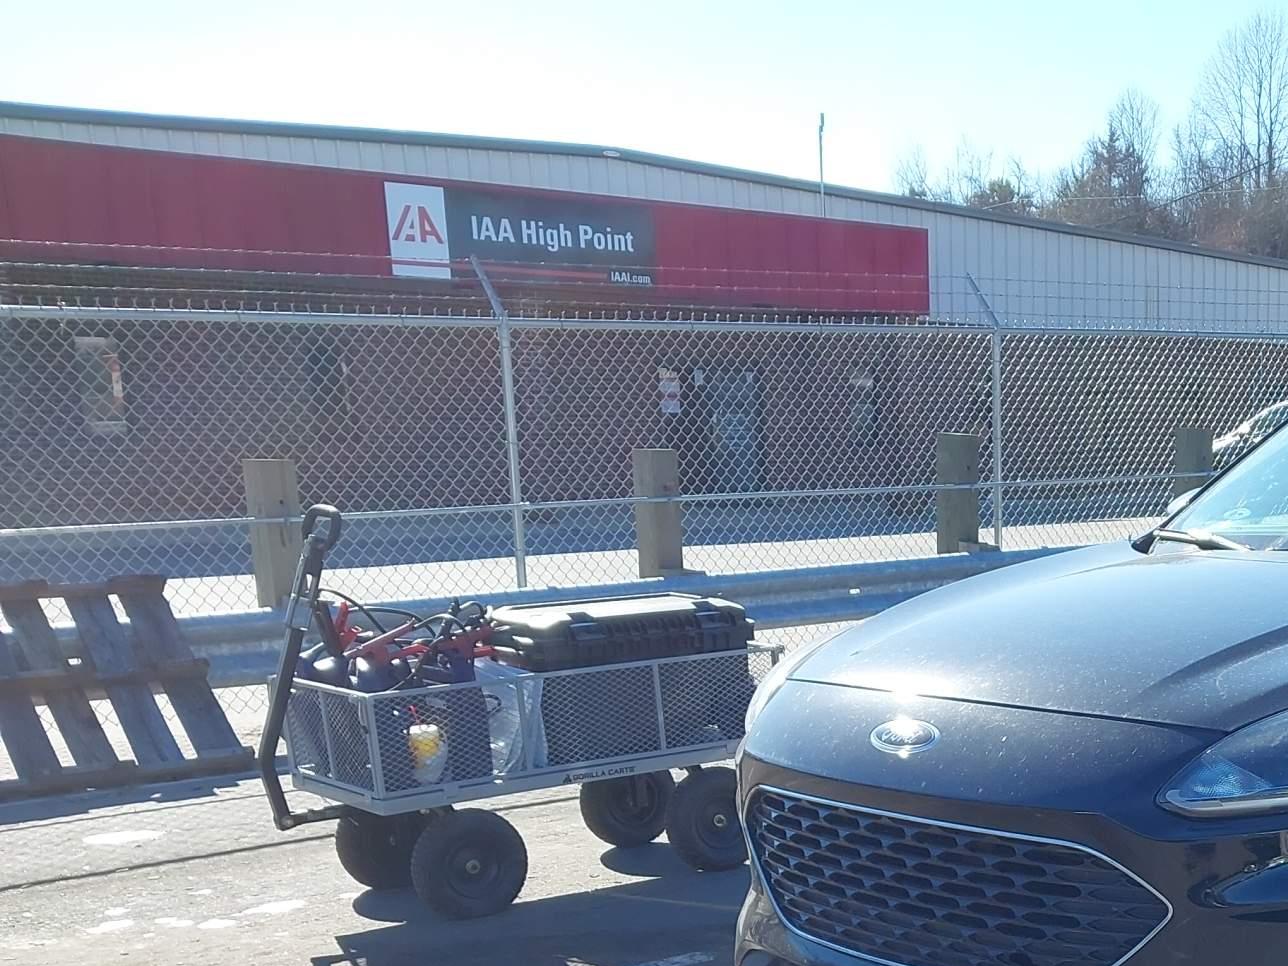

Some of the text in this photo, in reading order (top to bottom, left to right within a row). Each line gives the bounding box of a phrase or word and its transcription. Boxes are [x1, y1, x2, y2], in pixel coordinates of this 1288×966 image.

[470, 215, 634, 253] IAA High Point
